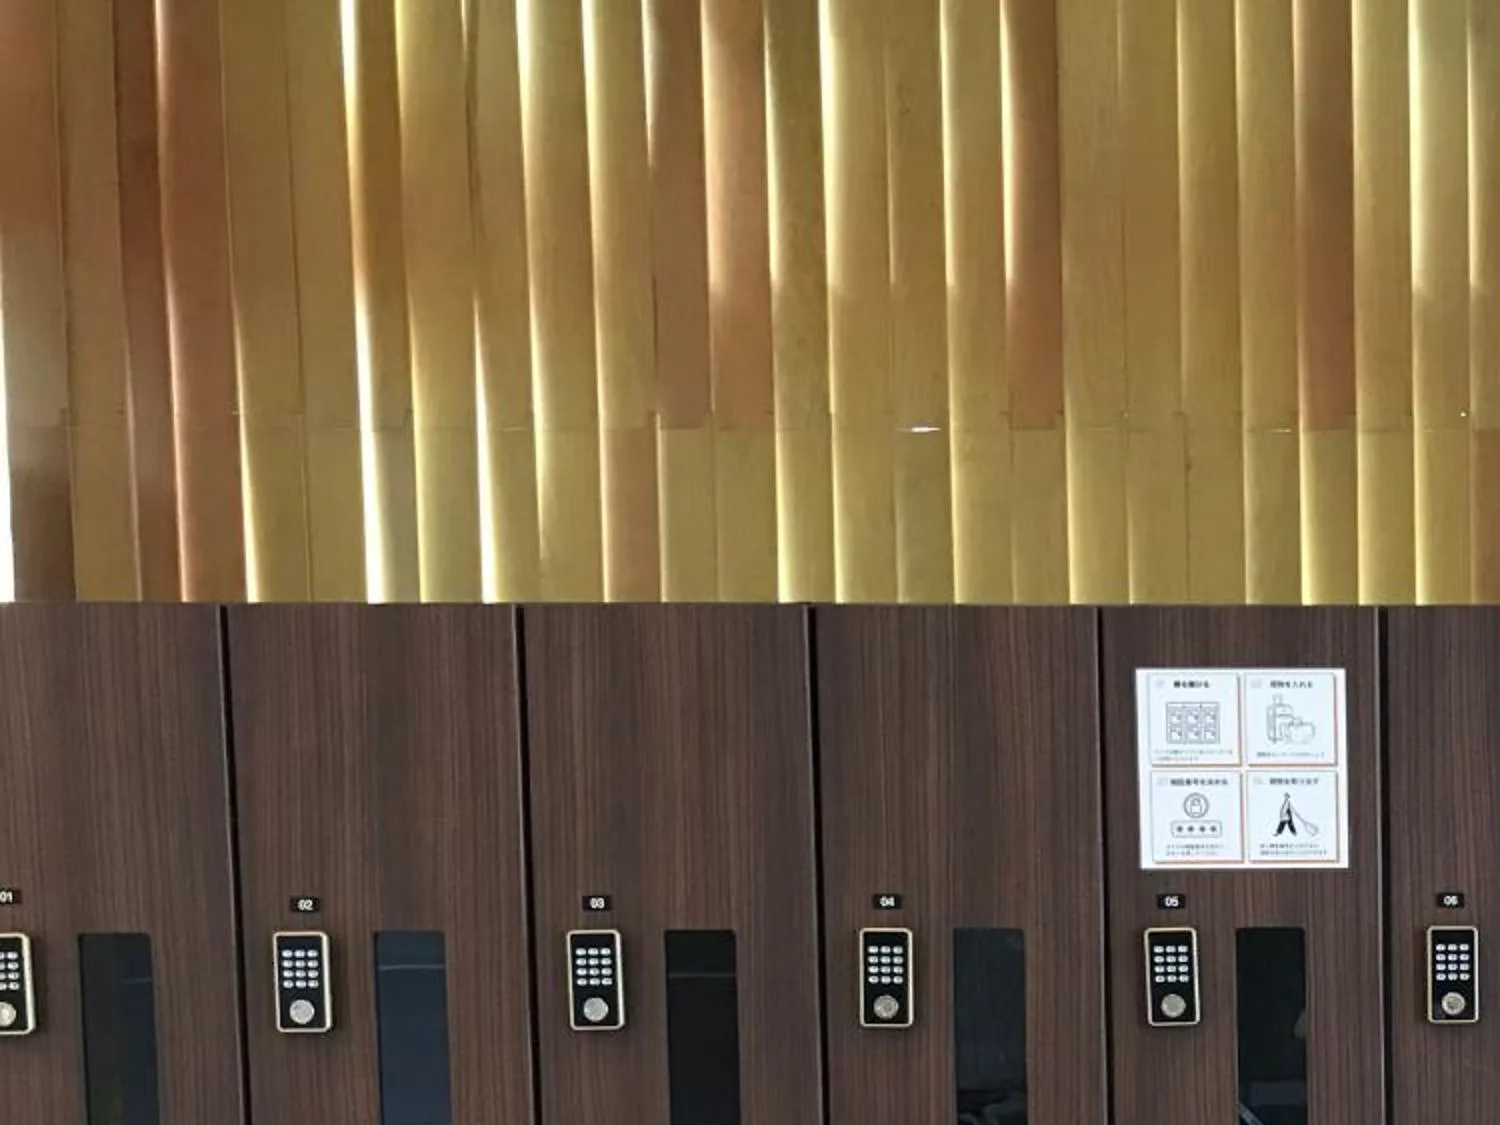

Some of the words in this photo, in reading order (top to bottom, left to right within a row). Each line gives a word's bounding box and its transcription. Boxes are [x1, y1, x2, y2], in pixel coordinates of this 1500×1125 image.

[298, 899, 313, 911] 02
[590, 897, 605, 909] 03
[1164, 895, 1179, 907] 05
